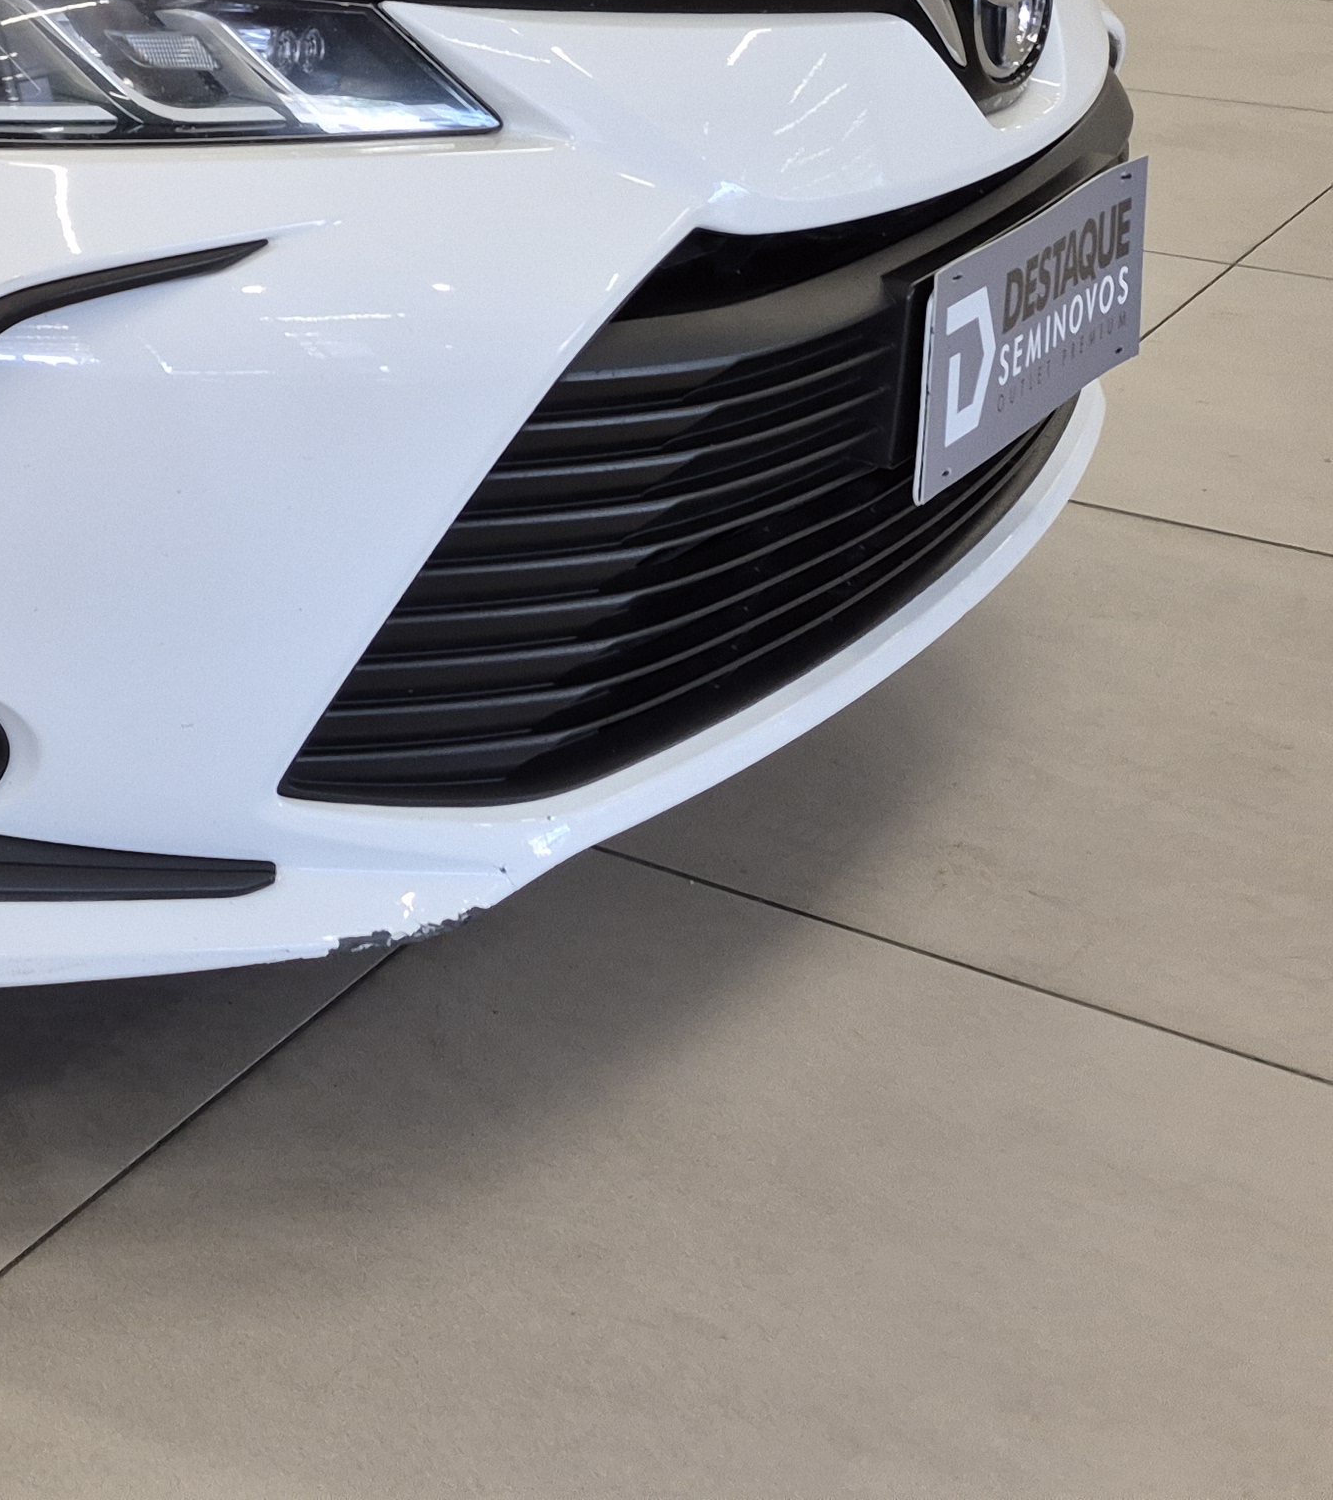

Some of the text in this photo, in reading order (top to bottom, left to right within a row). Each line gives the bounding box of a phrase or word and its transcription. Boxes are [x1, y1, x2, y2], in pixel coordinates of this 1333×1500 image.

[998, 265, 1129, 386] SEMINOVOS
[1002, 197, 1132, 334] DESTAQUE
[997, 310, 1127, 413] OUTLET PREMIUM
